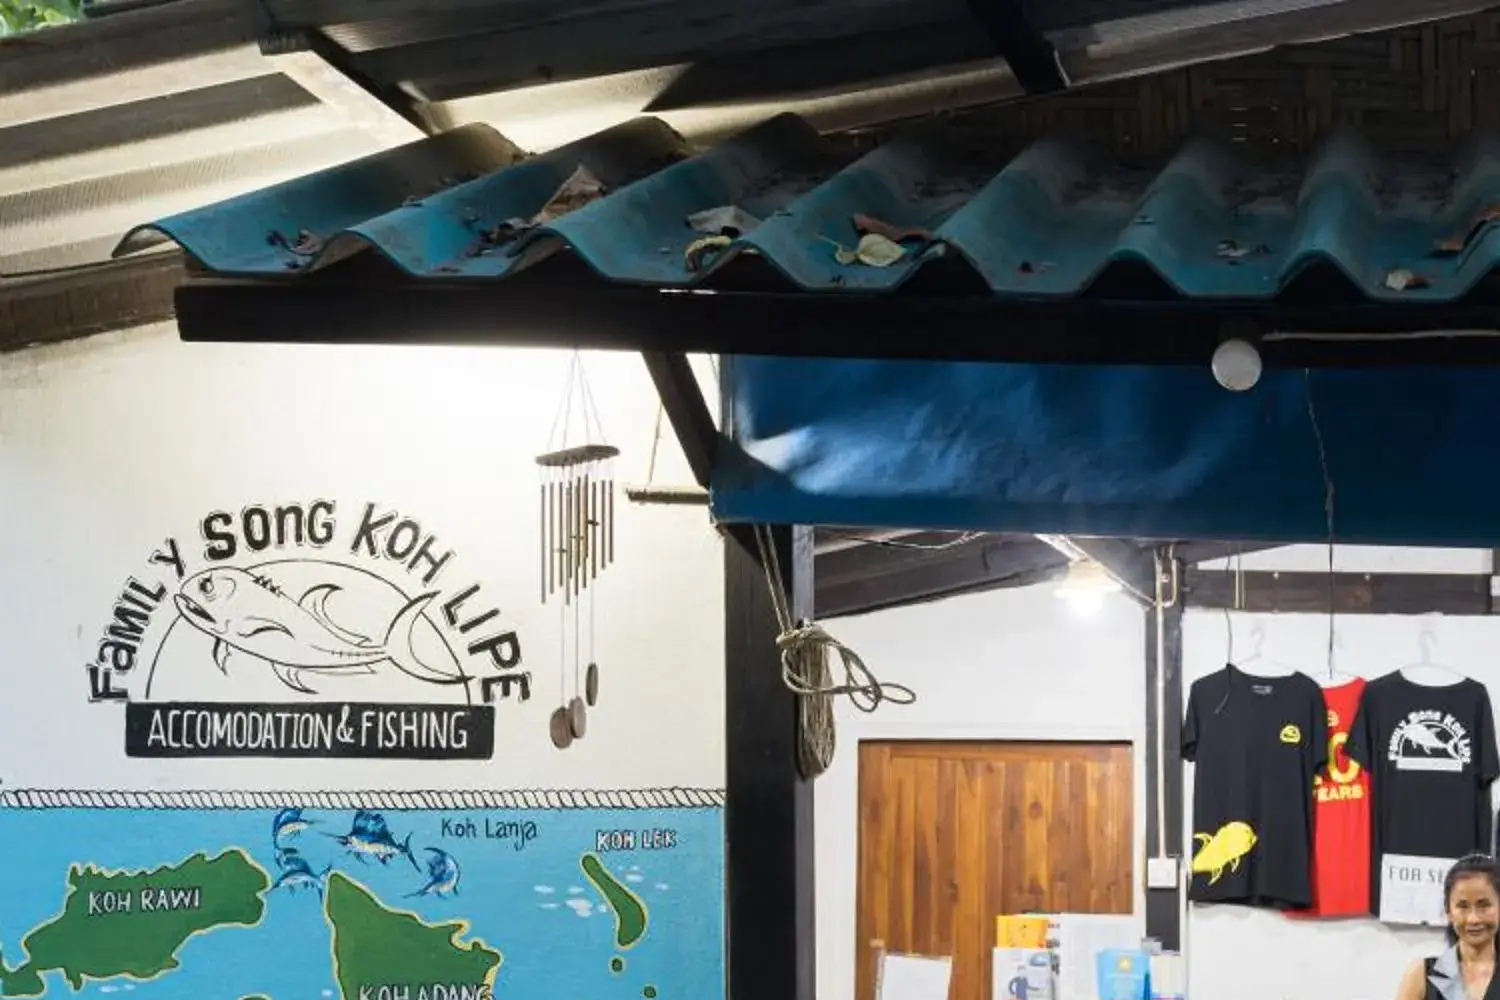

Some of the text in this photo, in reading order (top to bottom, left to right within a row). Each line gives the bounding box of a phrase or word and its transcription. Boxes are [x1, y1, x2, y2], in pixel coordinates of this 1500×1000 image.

[351, 502, 455, 583] KOH
[442, 583, 532, 703] LIPE
[147, 709, 333, 750] ACCOMODATION
[360, 709, 469, 750] FISHING
[1312, 785, 1363, 803] EARS
[440, 817, 538, 851] Koh Lanja
[595, 830, 637, 851] KOH
[88, 888, 201, 917] KOH RAWI
